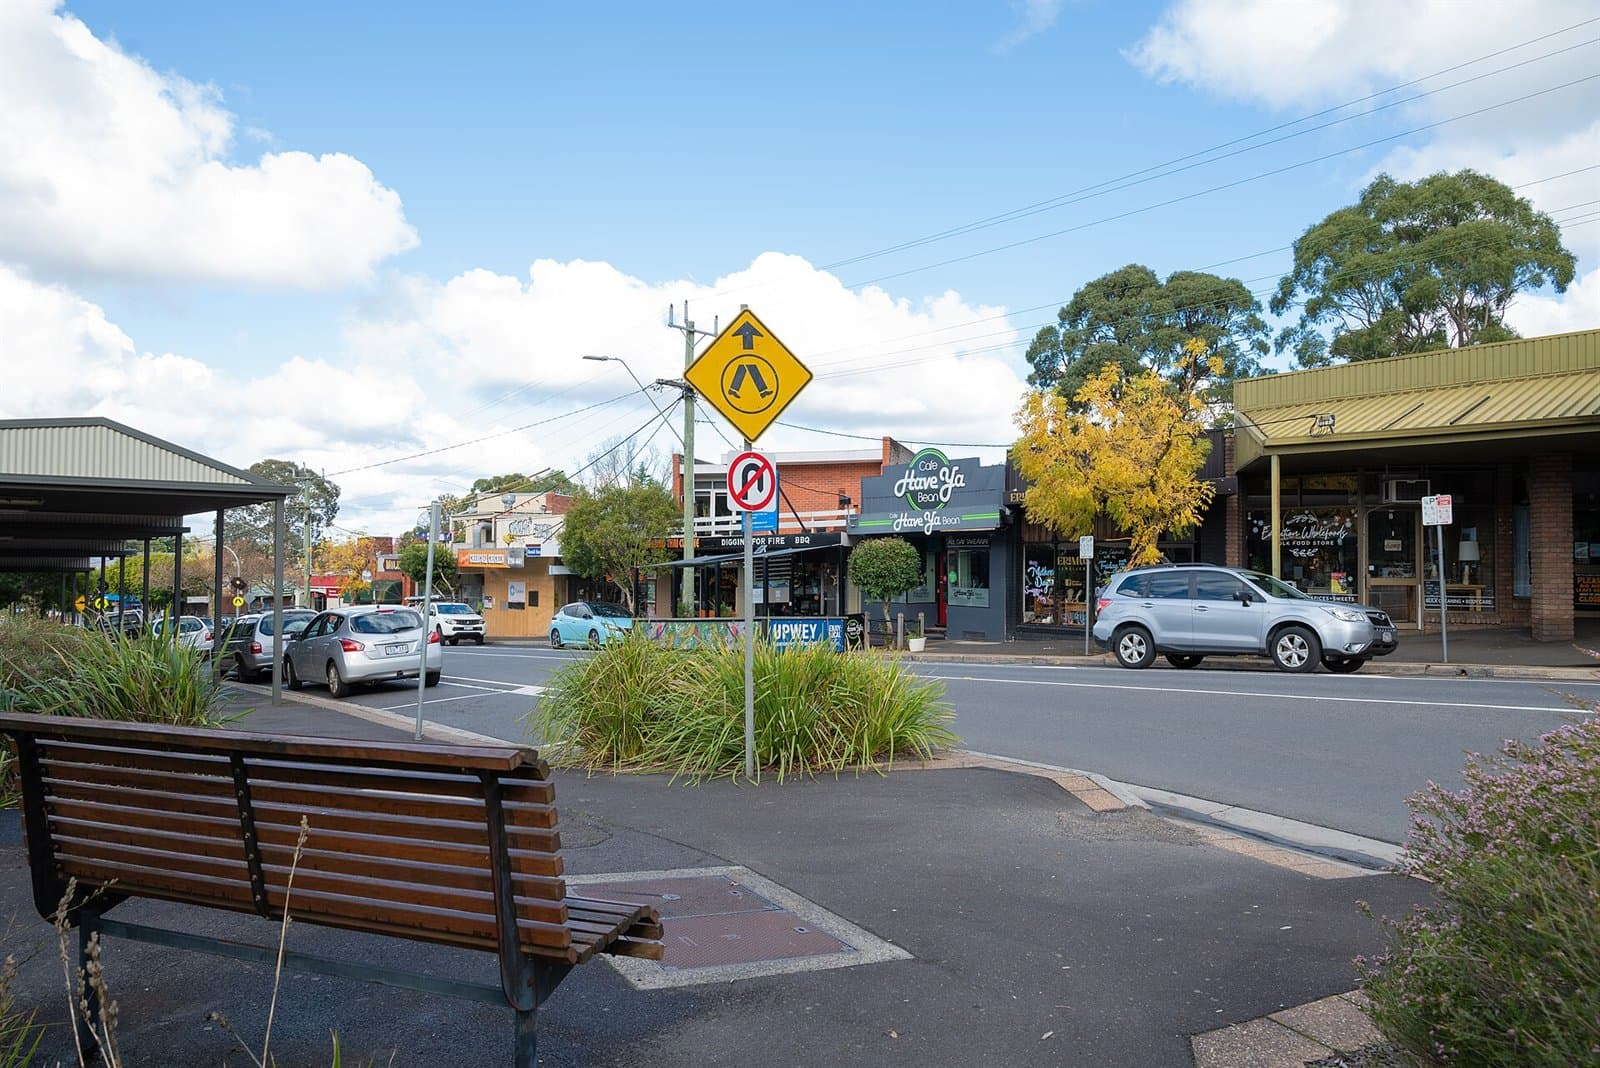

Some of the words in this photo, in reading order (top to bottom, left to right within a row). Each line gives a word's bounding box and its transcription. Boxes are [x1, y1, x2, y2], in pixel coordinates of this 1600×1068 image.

[918, 460, 939, 472] Cafe
[894, 469, 939, 497] Have
[939, 466, 966, 503] Ya
[917, 491, 939, 503] Bean
[893, 512, 924, 532] Have
[923, 511, 941, 535] Ya
[942, 516, 960, 525] Bean
[1302, 525, 1349, 540] Wholefoods
[752, 537, 766, 545] FOR
[768, 536, 785, 545] FIRE
[794, 536, 810, 544] BBQ
[773, 623, 817, 640] UPWEY
